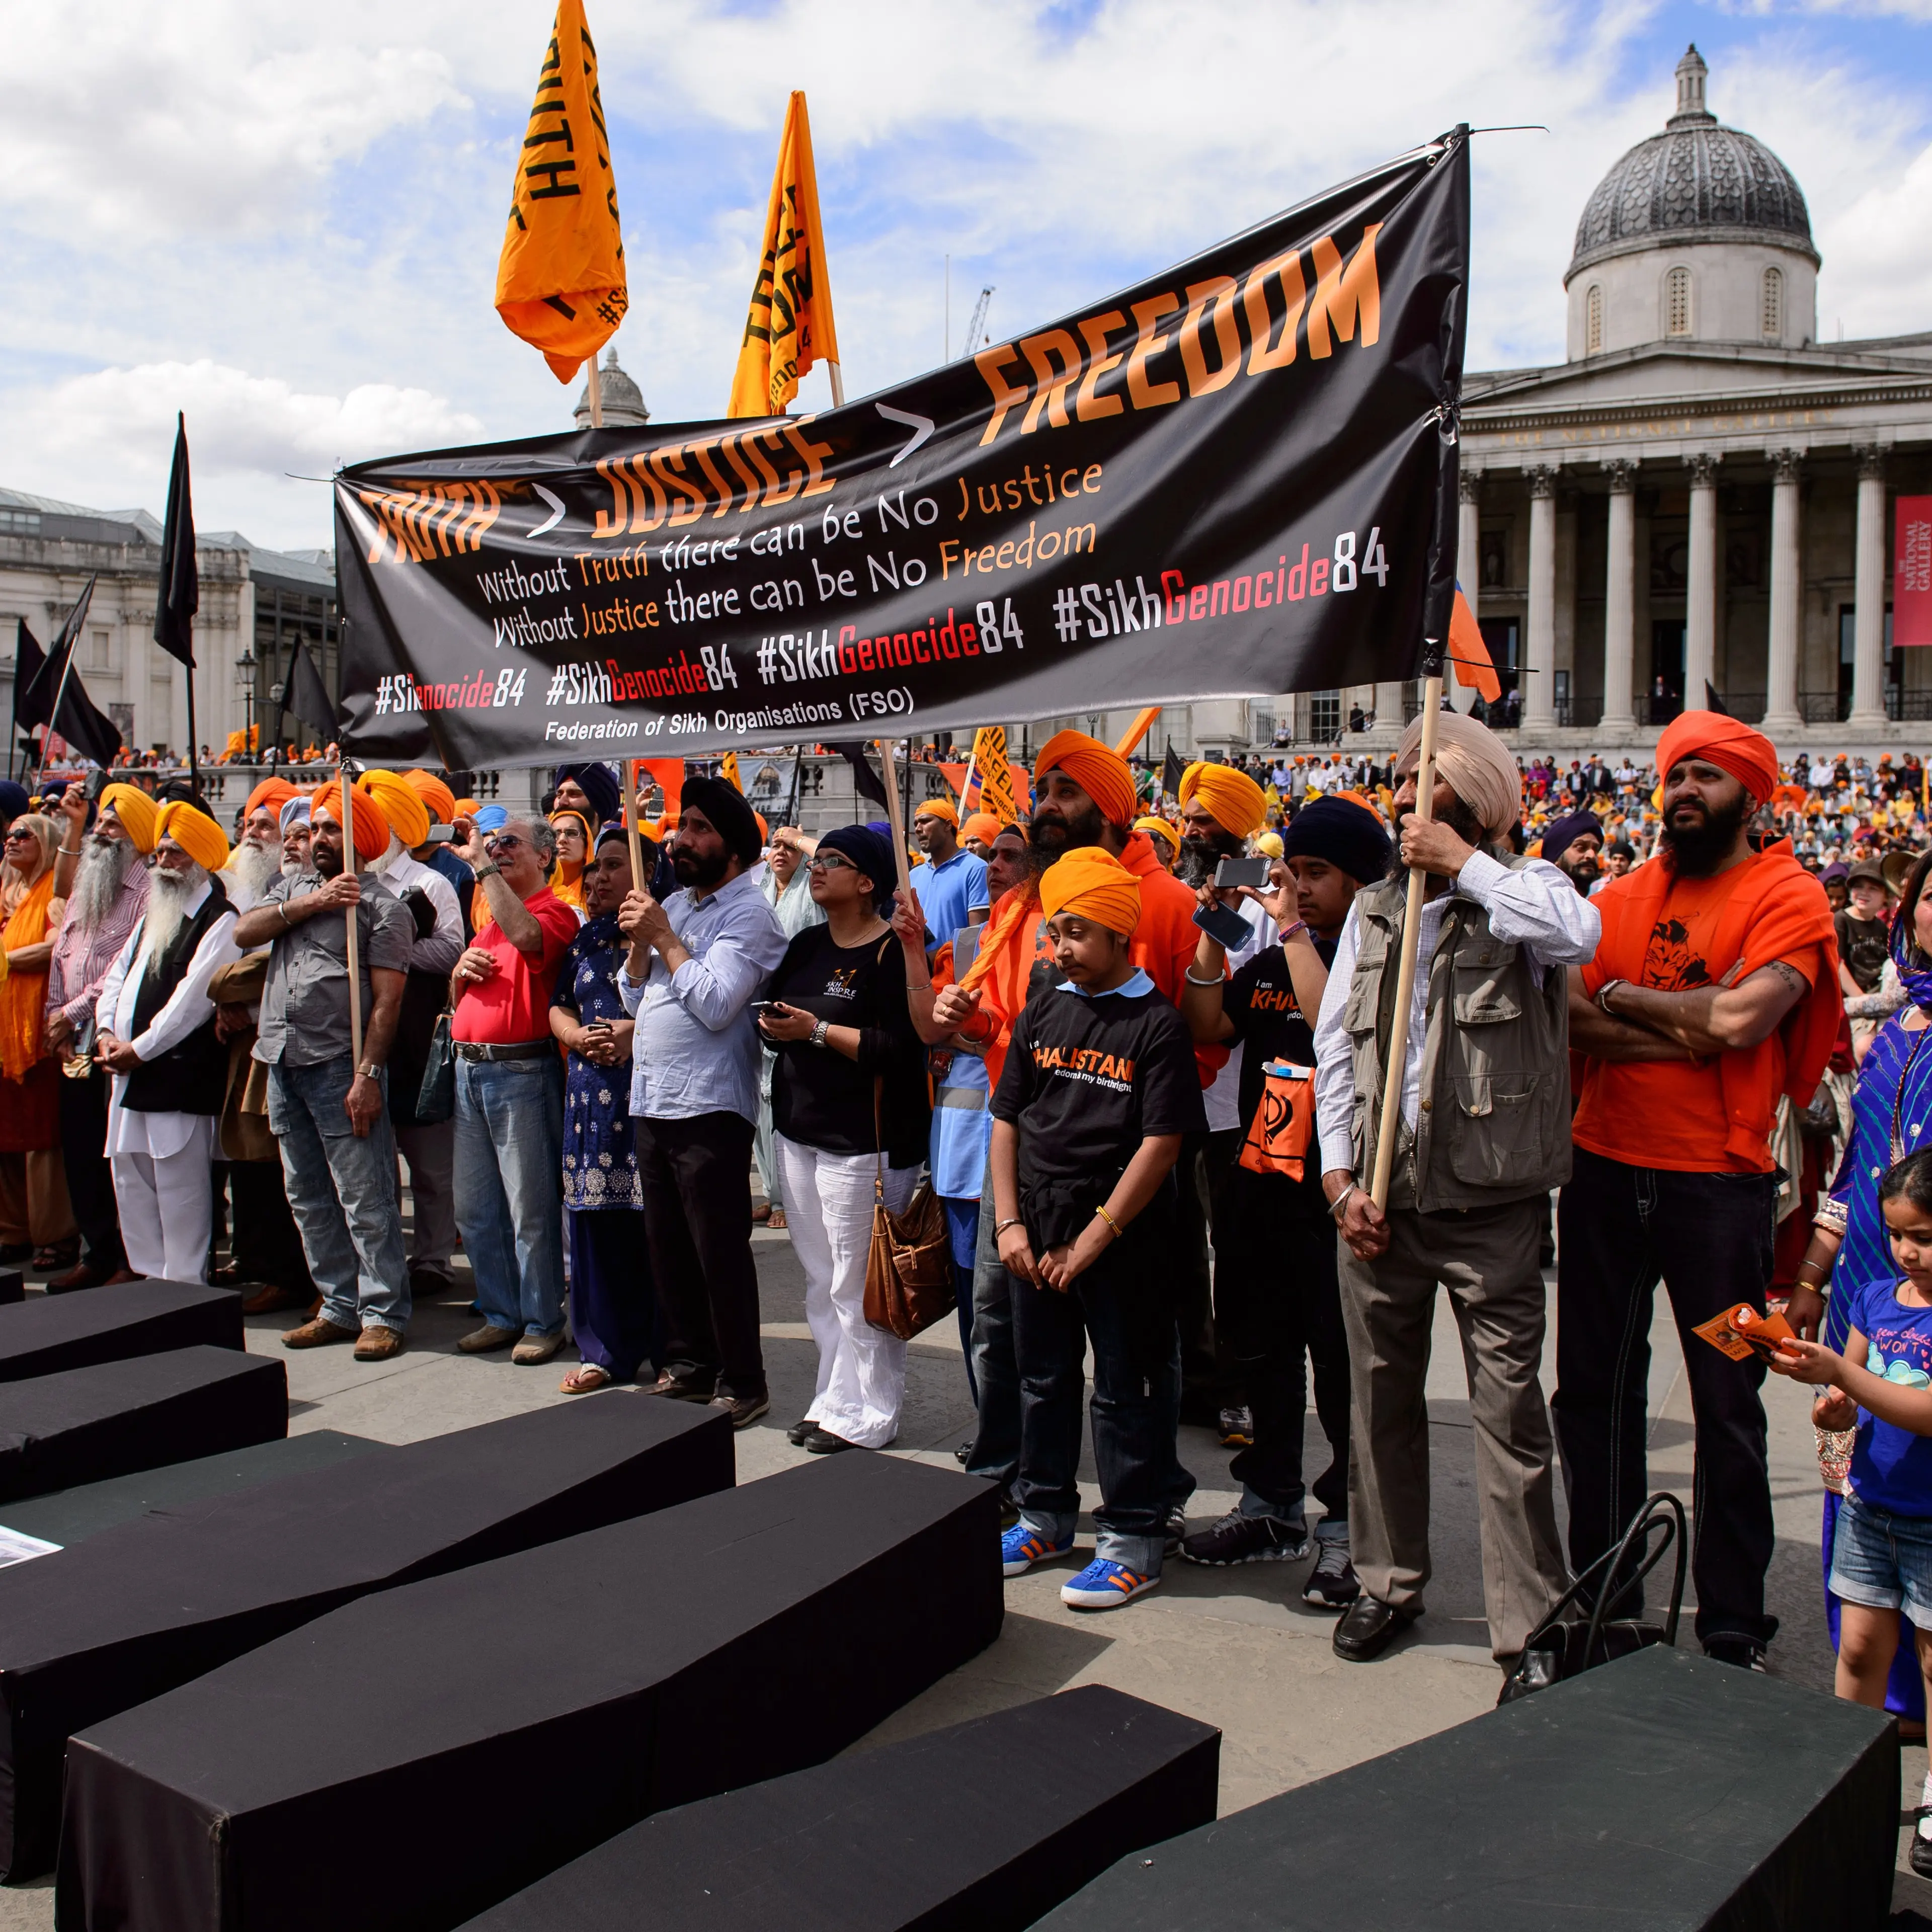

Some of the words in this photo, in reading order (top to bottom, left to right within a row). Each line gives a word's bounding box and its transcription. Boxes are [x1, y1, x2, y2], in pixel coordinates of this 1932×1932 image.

[360, 480, 501, 564] TRUTH
[592, 414, 837, 538] JUSTICE
[974, 221, 1384, 447] FREEDOM
[1563, 419, 1691, 442] NATIONAL
[1713, 409, 1833, 431] GALLERY
[477, 557, 571, 604] Without
[575, 541, 648, 586] Truth
[660, 534, 740, 572] there
[750, 522, 804, 557] can
[822, 504, 862, 544] be
[878, 491, 938, 533] No
[957, 464, 1102, 521] Justice
[1904, 520, 1918, 591] NATIONAL
[1916, 521, 1931, 592] GALLERY
[494, 606, 578, 648] Without
[584, 598, 659, 638] Justice
[665, 580, 741, 624] there
[750, 580, 804, 612] can
[812, 558, 857, 602] be
[866, 551, 927, 593] No
[939, 521, 1096, 581] Freedom
[546, 644, 738, 706] #SikhGenocide84
[757, 598, 1024, 685] #SikhGenocide84
[1053, 526, 1390, 642] #SikhGenocide84
[545, 718, 638, 741] Federation
[645, 716, 665, 736] of
[669, 713, 707, 735] Sikh
[715, 698, 842, 734] Organisations
[849, 686, 914, 721] (FSO)
[1082, 1073, 1096, 1084] my
[1096, 1076, 1132, 1092] birthright
